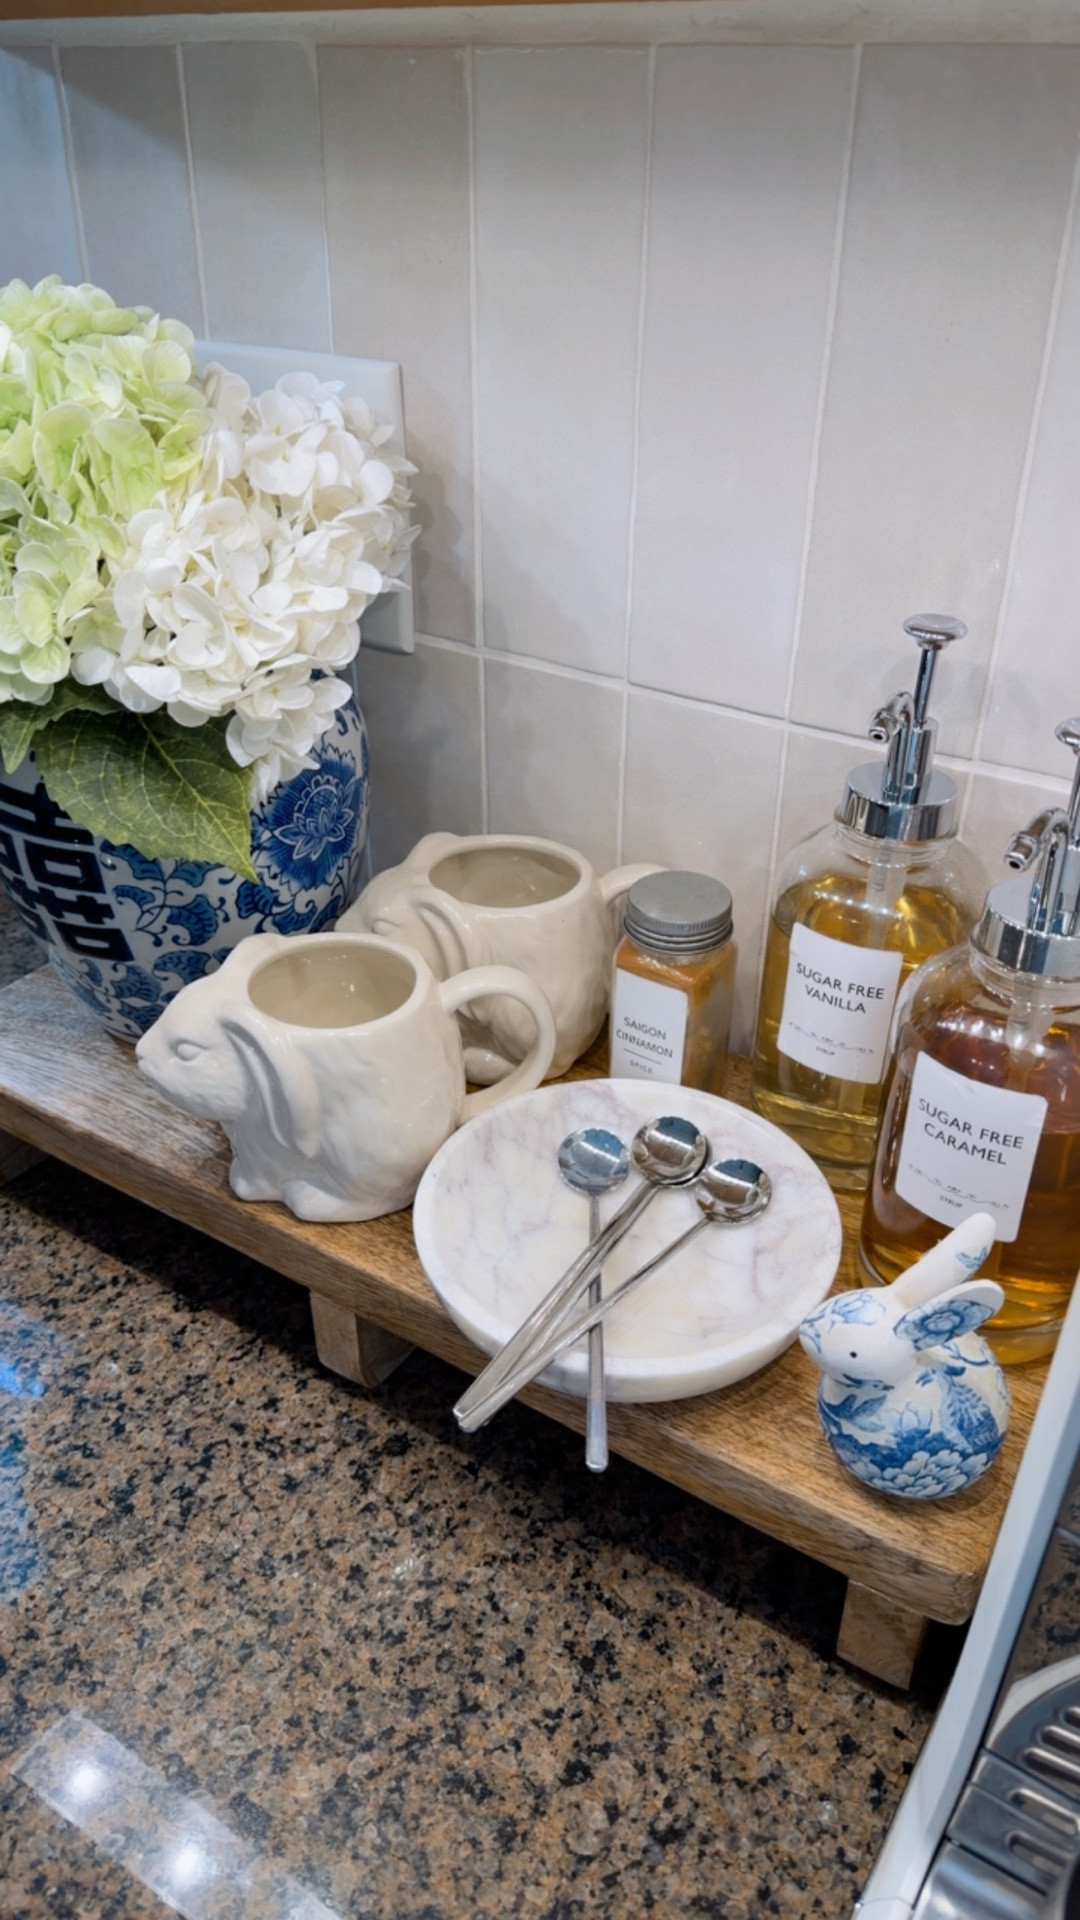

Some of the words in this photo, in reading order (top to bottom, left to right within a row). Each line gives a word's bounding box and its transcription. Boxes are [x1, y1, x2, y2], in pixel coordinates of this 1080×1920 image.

[796, 962, 843, 992] SUGAR
[847, 983, 885, 1000] FREE
[804, 984, 866, 1014] VANILLA
[615, 1028, 673, 1059] CINNAMON
[623, 1016, 667, 1041] SAIGON
[629, 1059, 653, 1074] SPICE
[918, 1098, 972, 1136] SUGAR
[979, 1127, 1025, 1150] FREE
[924, 1122, 1007, 1165] CARAMEL
